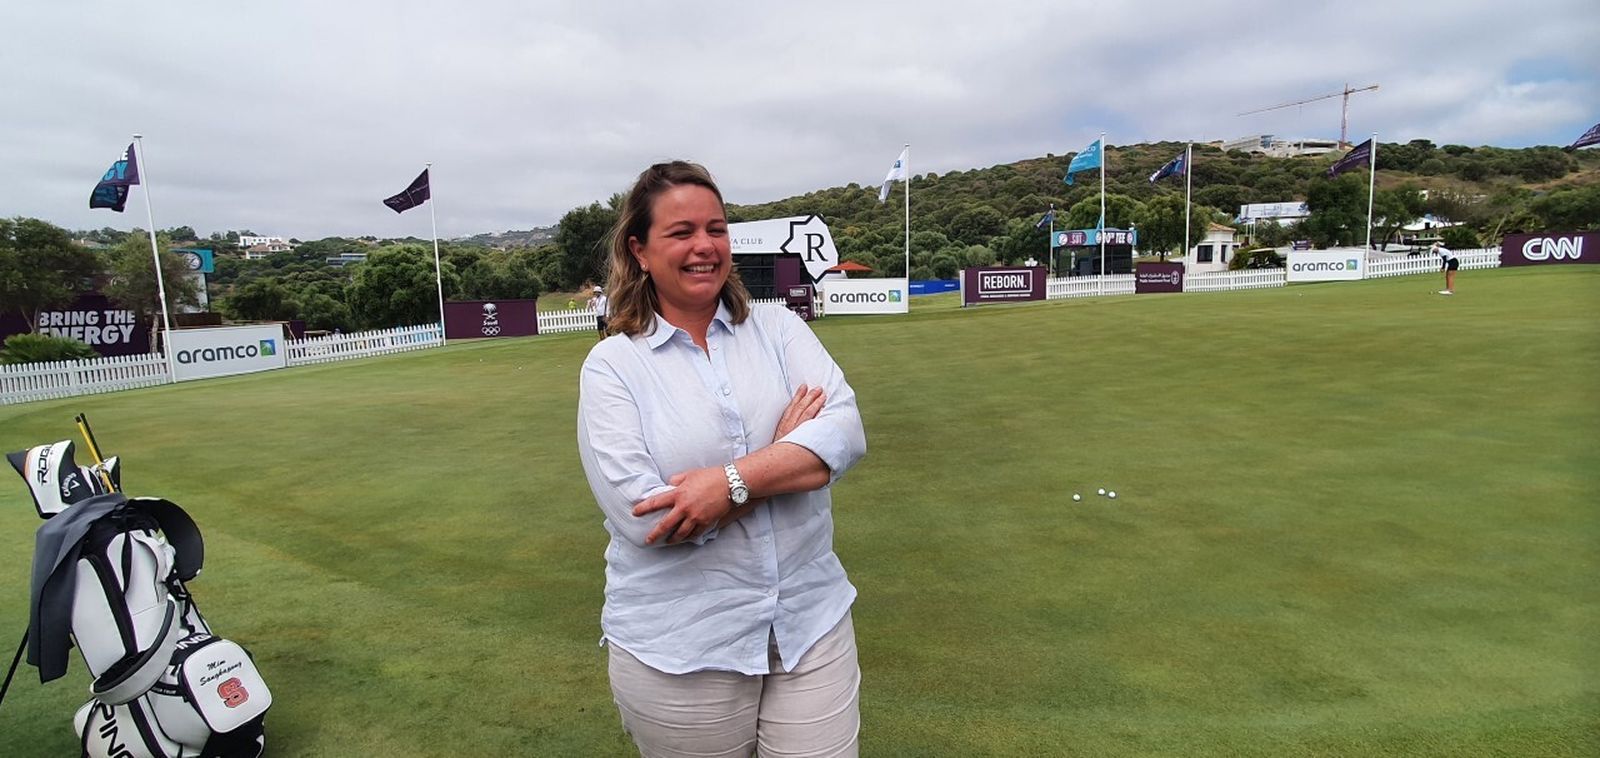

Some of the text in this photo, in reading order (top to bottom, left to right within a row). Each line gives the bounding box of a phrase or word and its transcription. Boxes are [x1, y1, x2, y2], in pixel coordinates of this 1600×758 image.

[804, 233, 828, 262] R
[1522, 236, 1583, 260] CNN
[1292, 262, 1344, 272] aramco
[984, 275, 1027, 289] REBORN.
[830, 293, 886, 303] aramco
[40, 310, 136, 327] BRING THE
[40, 325, 135, 345] ENERGY
[177, 345, 258, 364] aramco
[175, 634, 212, 650] ING
